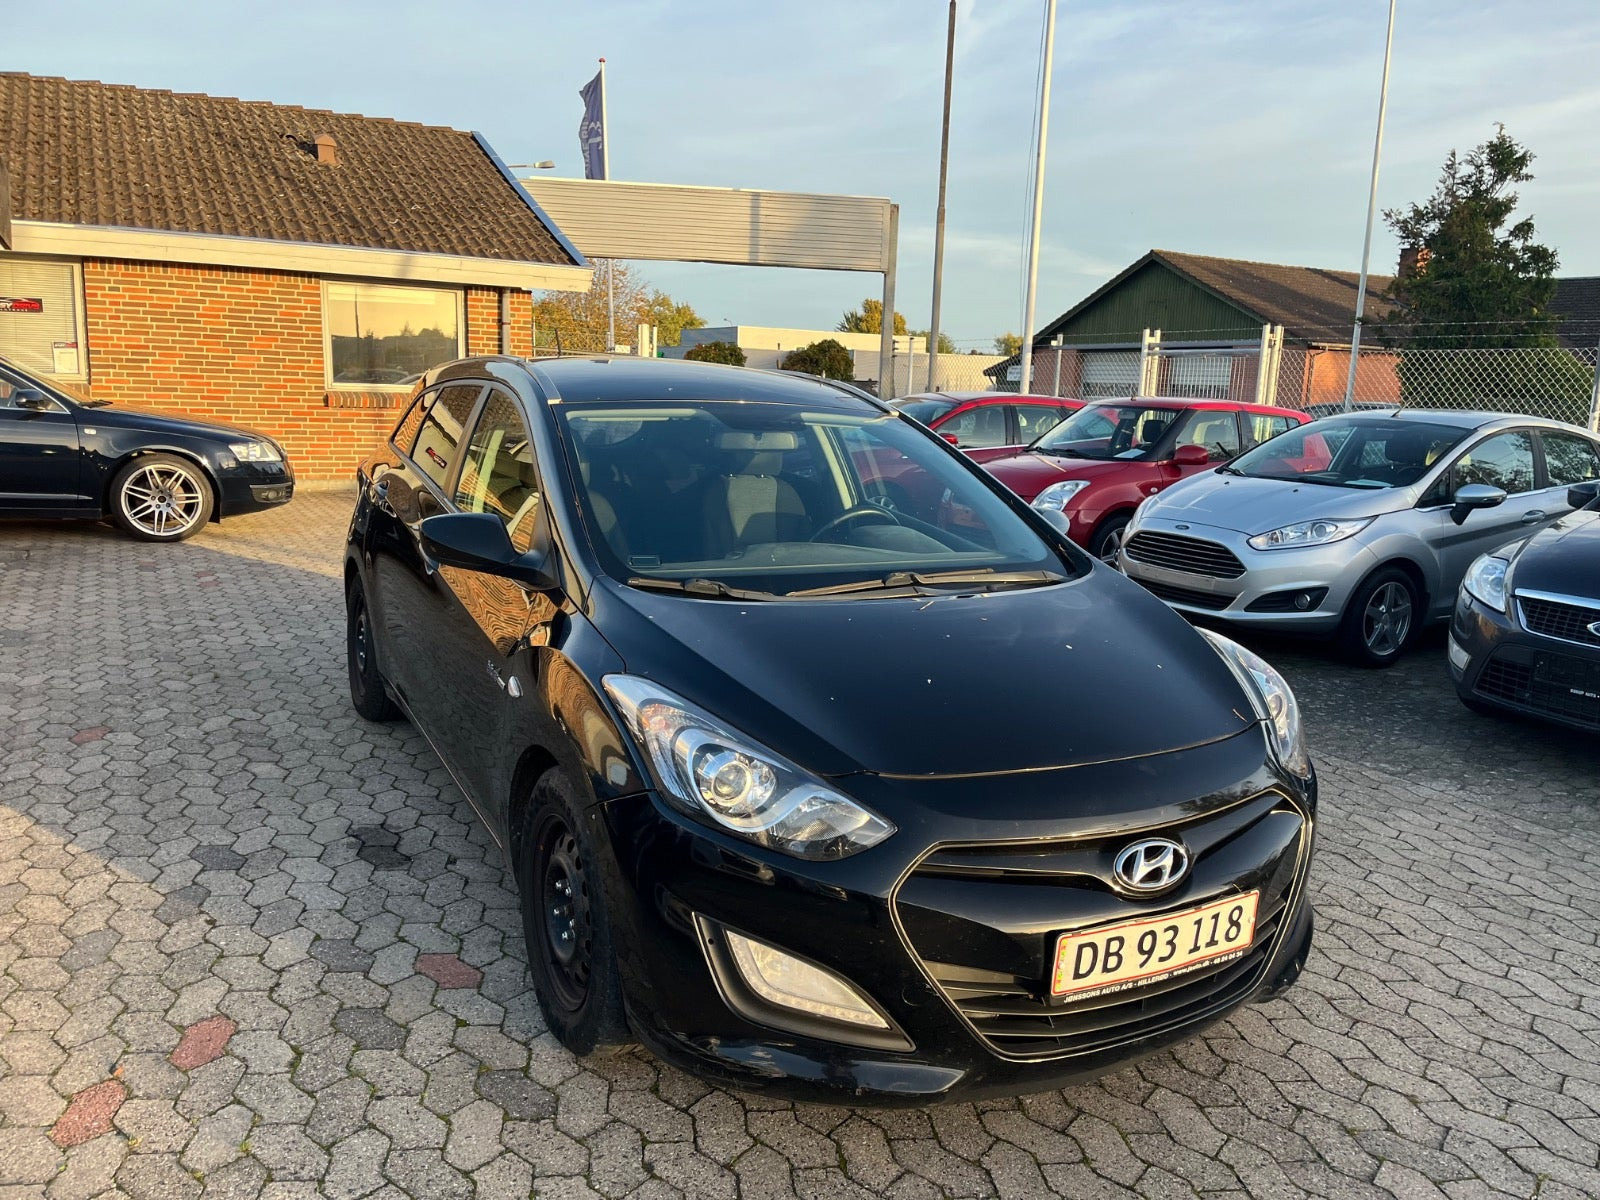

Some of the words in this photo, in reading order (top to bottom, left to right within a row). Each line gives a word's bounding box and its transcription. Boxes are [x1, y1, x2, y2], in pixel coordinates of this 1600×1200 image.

[1072, 935, 1125, 981] DB
[1137, 924, 1179, 969] 93
[1188, 905, 1243, 955] 118
[1102, 984, 1121, 995] AUTO
[1138, 974, 1169, 986] HILLERØD
